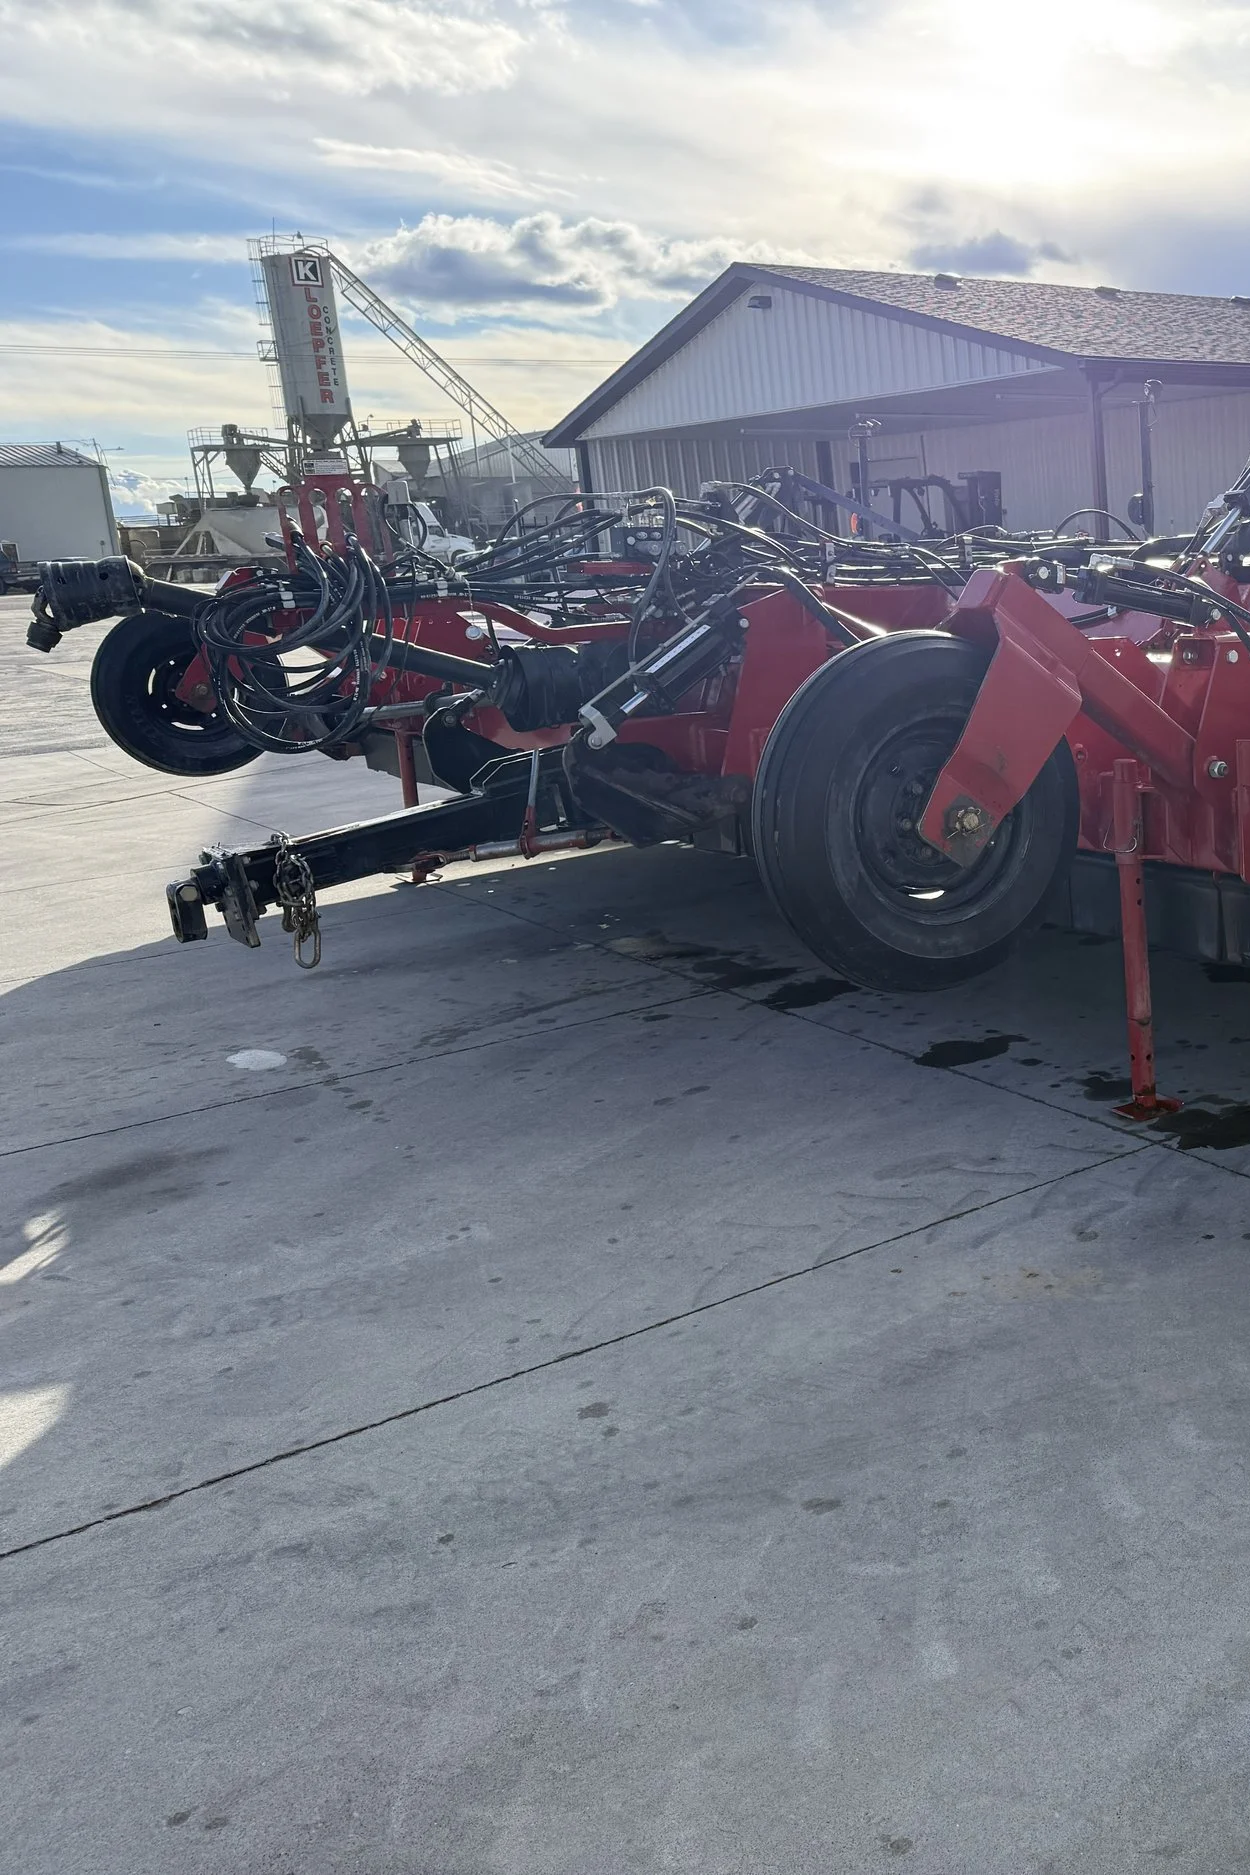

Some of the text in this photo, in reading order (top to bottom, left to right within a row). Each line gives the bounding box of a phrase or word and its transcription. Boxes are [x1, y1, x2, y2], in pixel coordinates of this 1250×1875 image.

[297, 260, 318, 281] K
[304, 287, 334, 403] LOEPFER
[322, 306, 339, 386] CONCRETE
